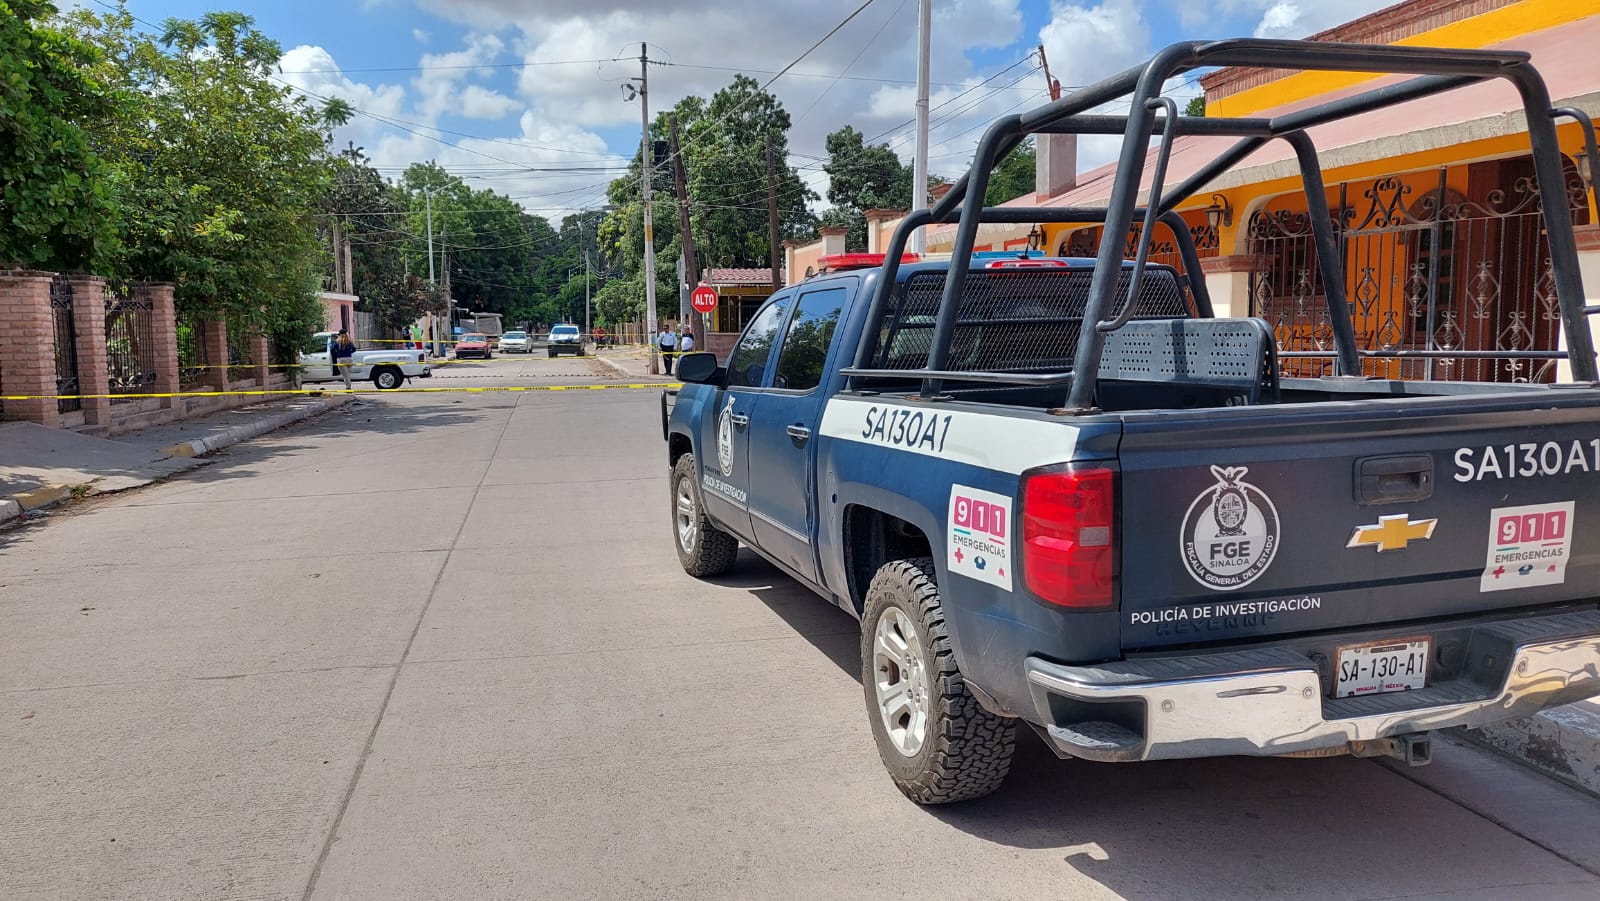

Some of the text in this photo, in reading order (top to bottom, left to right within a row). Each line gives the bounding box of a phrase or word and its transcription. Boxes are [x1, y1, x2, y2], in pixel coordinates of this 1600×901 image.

[695, 294, 714, 305] ALTO
[862, 406, 952, 452] SA130A1
[1454, 438, 1600, 482] SA130A1
[957, 500, 1001, 532] 911
[1503, 515, 1560, 540] 911
[953, 535, 1006, 558] EMERGENCIAS
[1210, 541, 1251, 560] FGE
[1495, 548, 1563, 564] EMERGENCIAS
[1205, 575, 1242, 585] GENERAL
[1242, 566, 1258, 581] DEL
[1257, 535, 1275, 568] ESTADO
[1210, 558, 1250, 568] SINALOA
[1131, 596, 1321, 624] POLICÍA DE INVESTIGACIÓN
[1339, 652, 1424, 682] SA-130-A1
